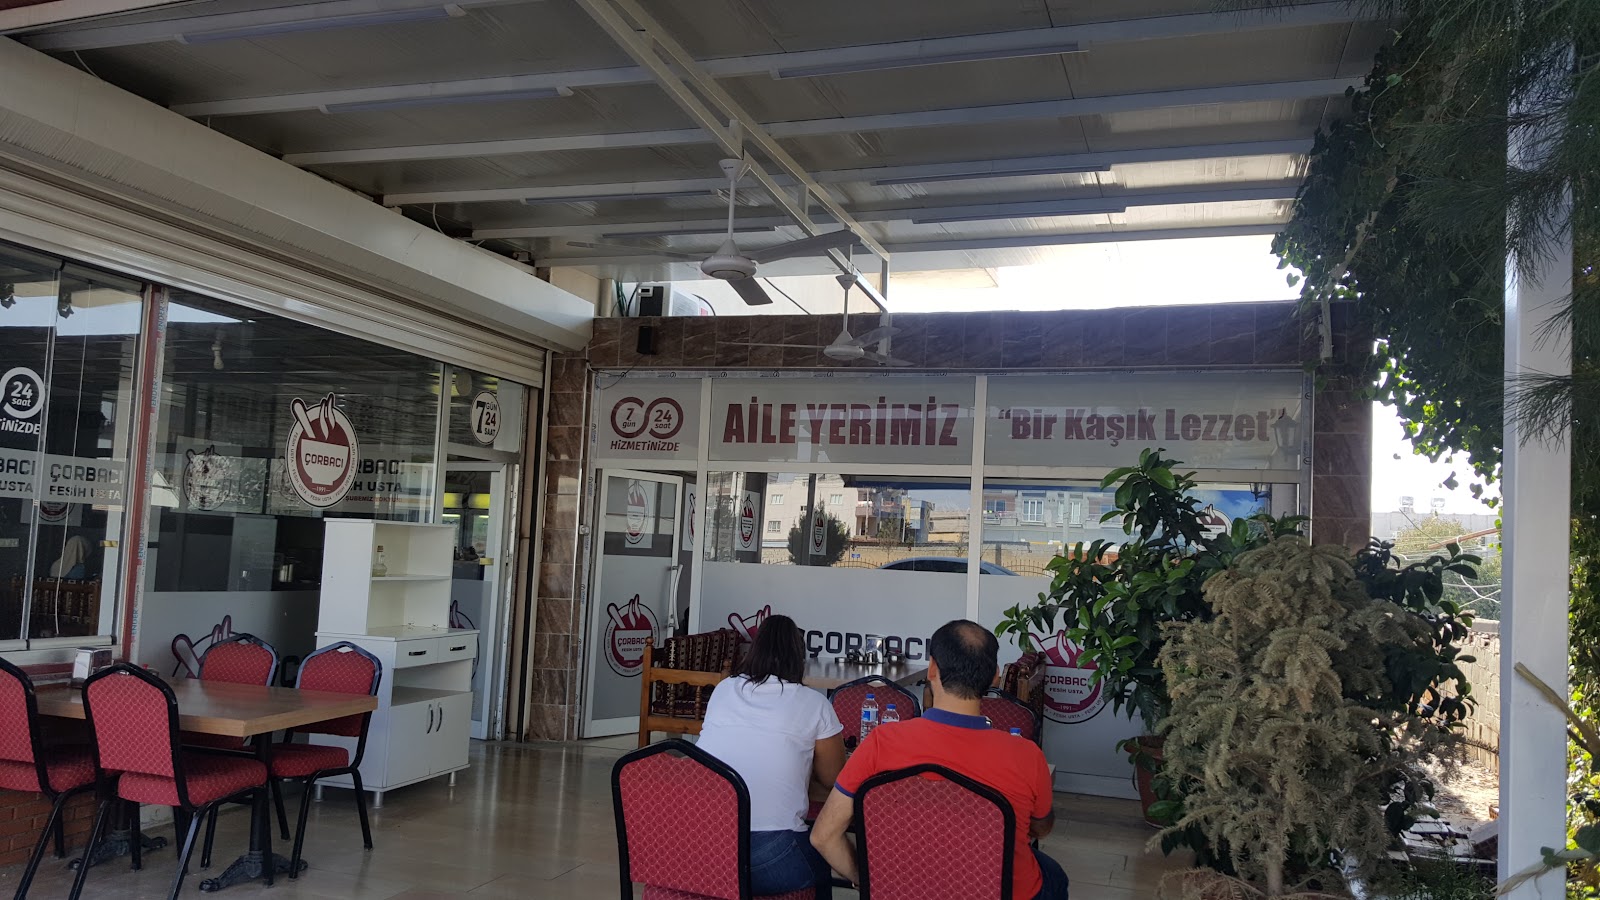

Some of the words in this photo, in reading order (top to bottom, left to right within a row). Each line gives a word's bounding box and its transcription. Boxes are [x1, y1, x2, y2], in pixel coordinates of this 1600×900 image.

[11, 381, 33, 400] 24
[11, 397, 31, 407] saat
[486, 401, 498, 411] GÜN
[476, 400, 486, 434] 7
[485, 411, 497, 427] 24
[625, 407, 635, 421] 7
[654, 409, 672, 422] 24
[722, 396, 797, 444] AİLE
[806, 396, 960, 446] YERİMİZ
[484, 427, 496, 437] SAAT
[622, 420, 636, 429] gün
[1064, 408, 1157, 447] Kaşık
[304, 452, 344, 469] ÇORBACI
[50, 464, 123, 484] ÇORBACI
[316, 485, 327, 493] 1991
